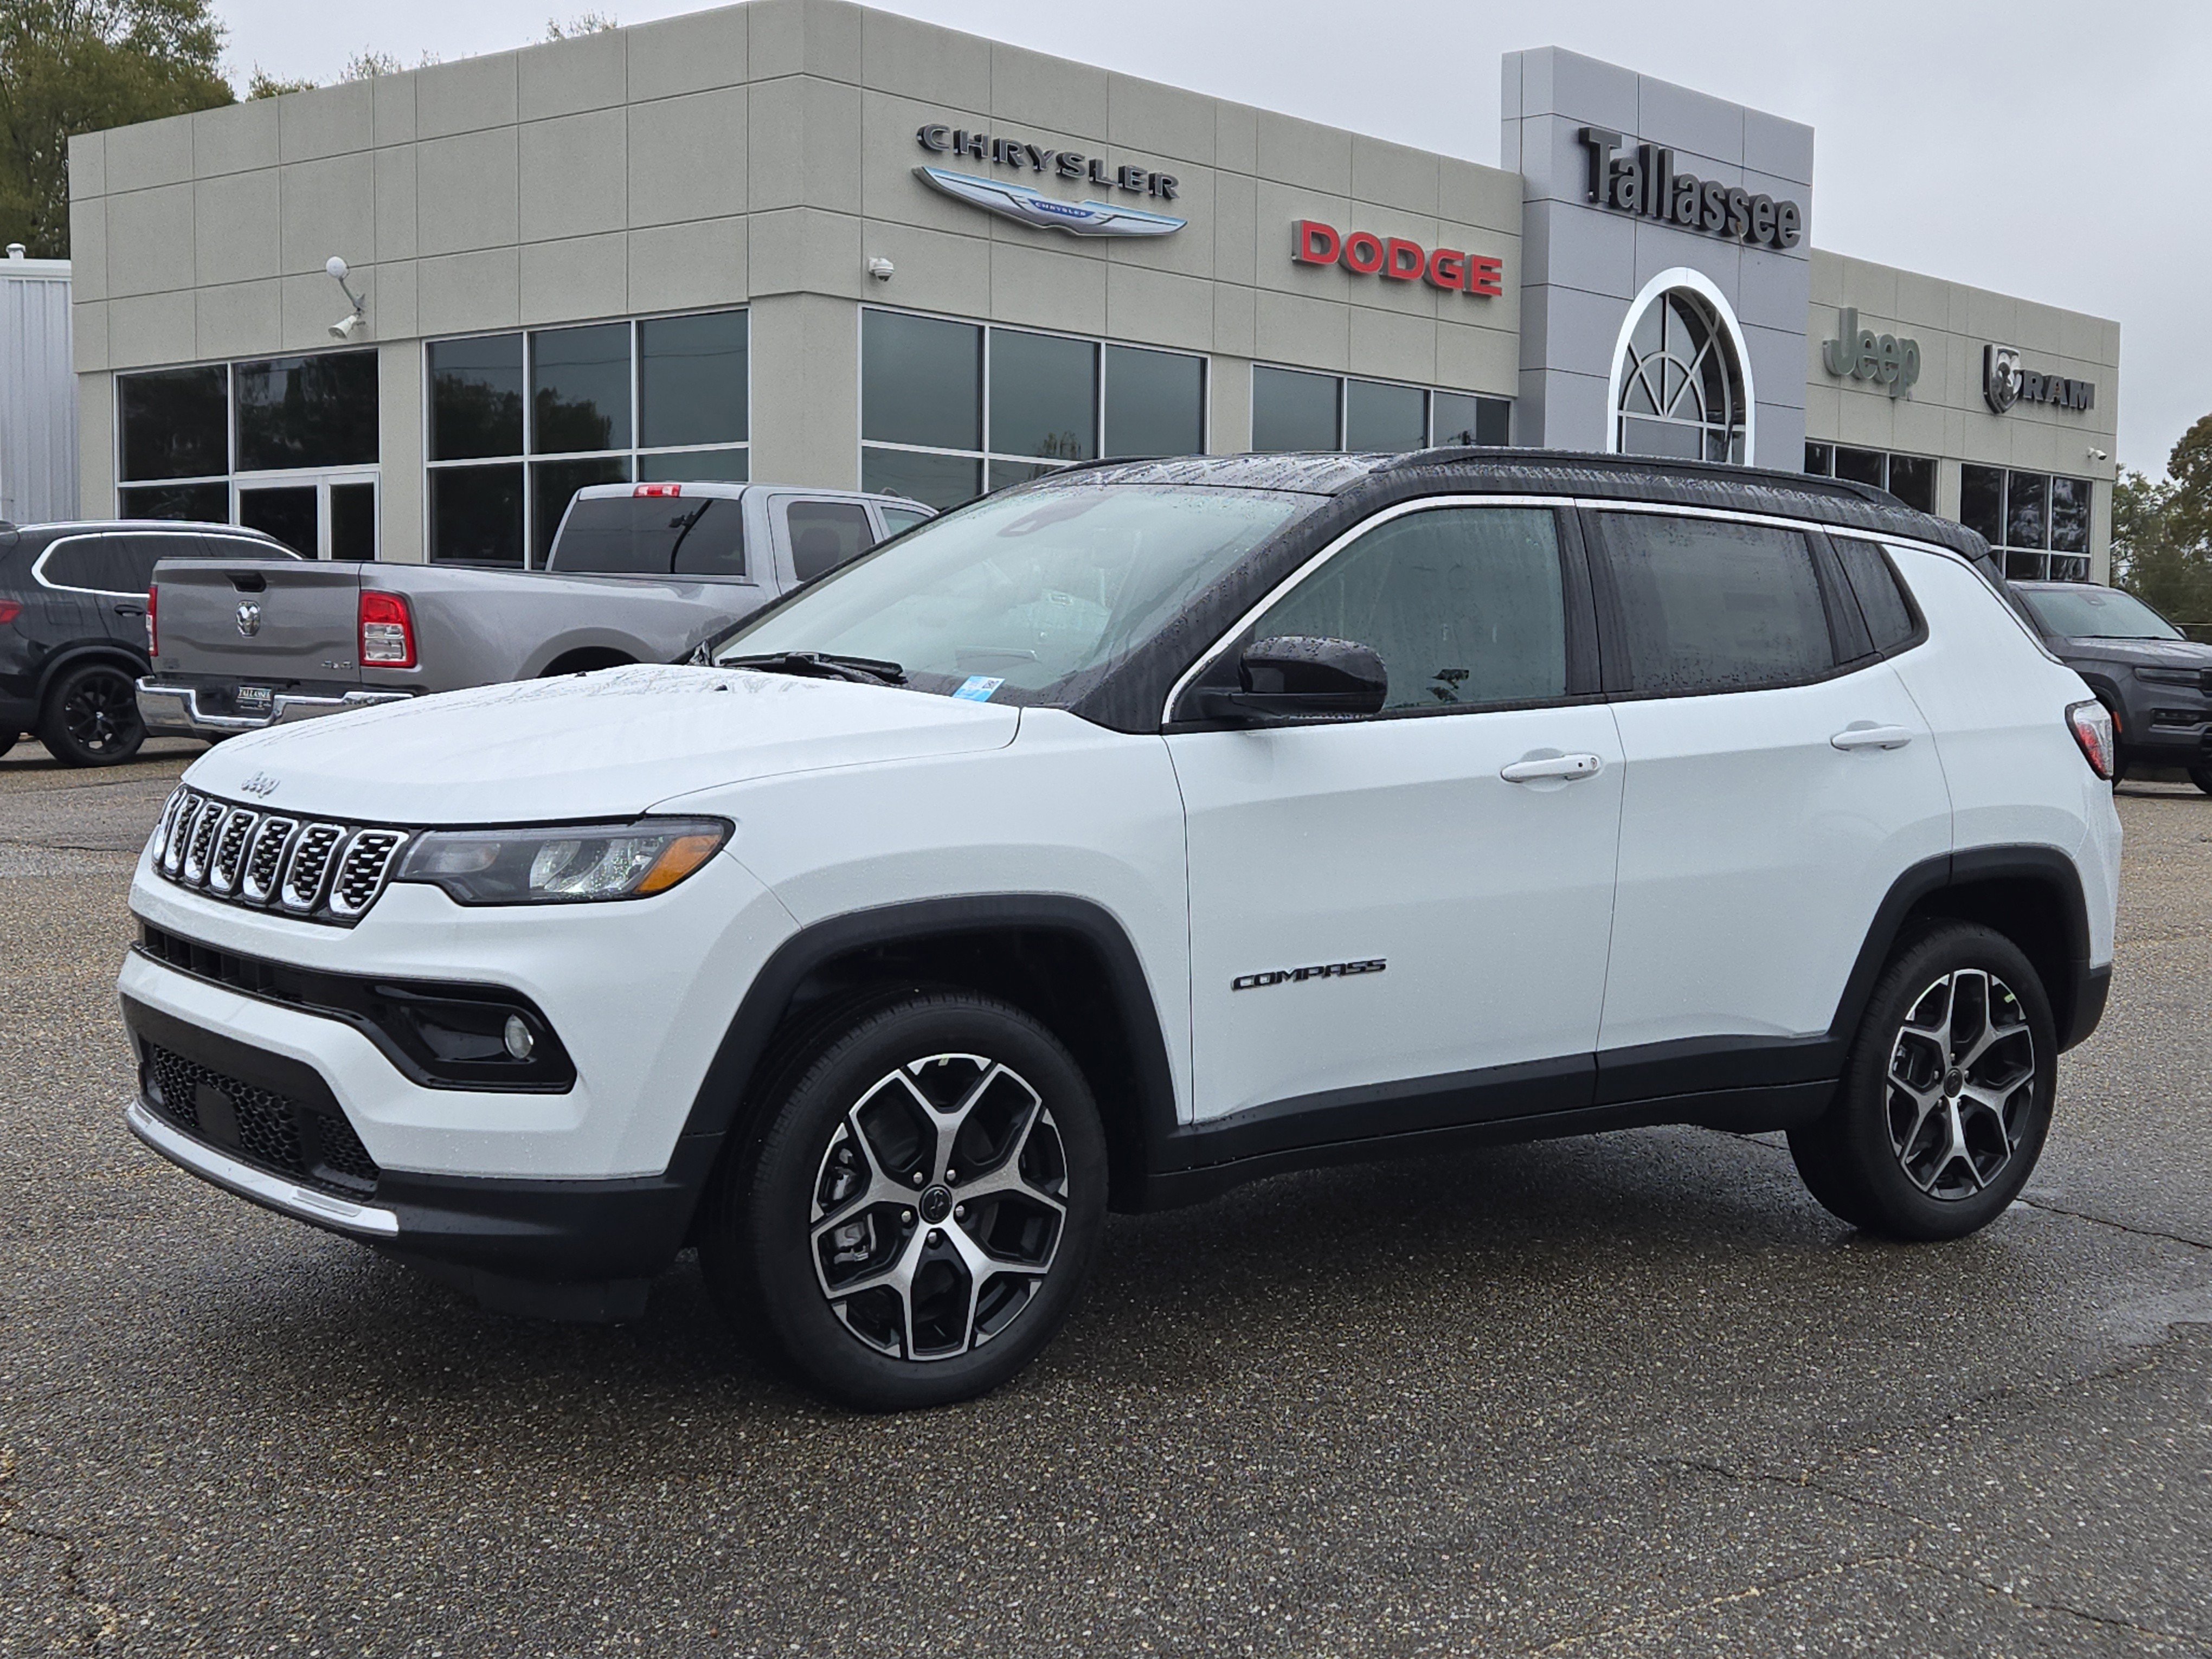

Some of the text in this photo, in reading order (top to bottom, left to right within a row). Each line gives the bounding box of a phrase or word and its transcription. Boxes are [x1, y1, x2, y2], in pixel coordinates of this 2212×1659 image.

[916, 123, 1180, 199] CHRYSLER
[1579, 127, 1801, 249] Tallassee
[1292, 220, 1502, 297] DODGE
[1822, 307, 1920, 398] Jeep
[2021, 370, 2095, 410] RAM
[1231, 958, 1387, 992] COMPASS
